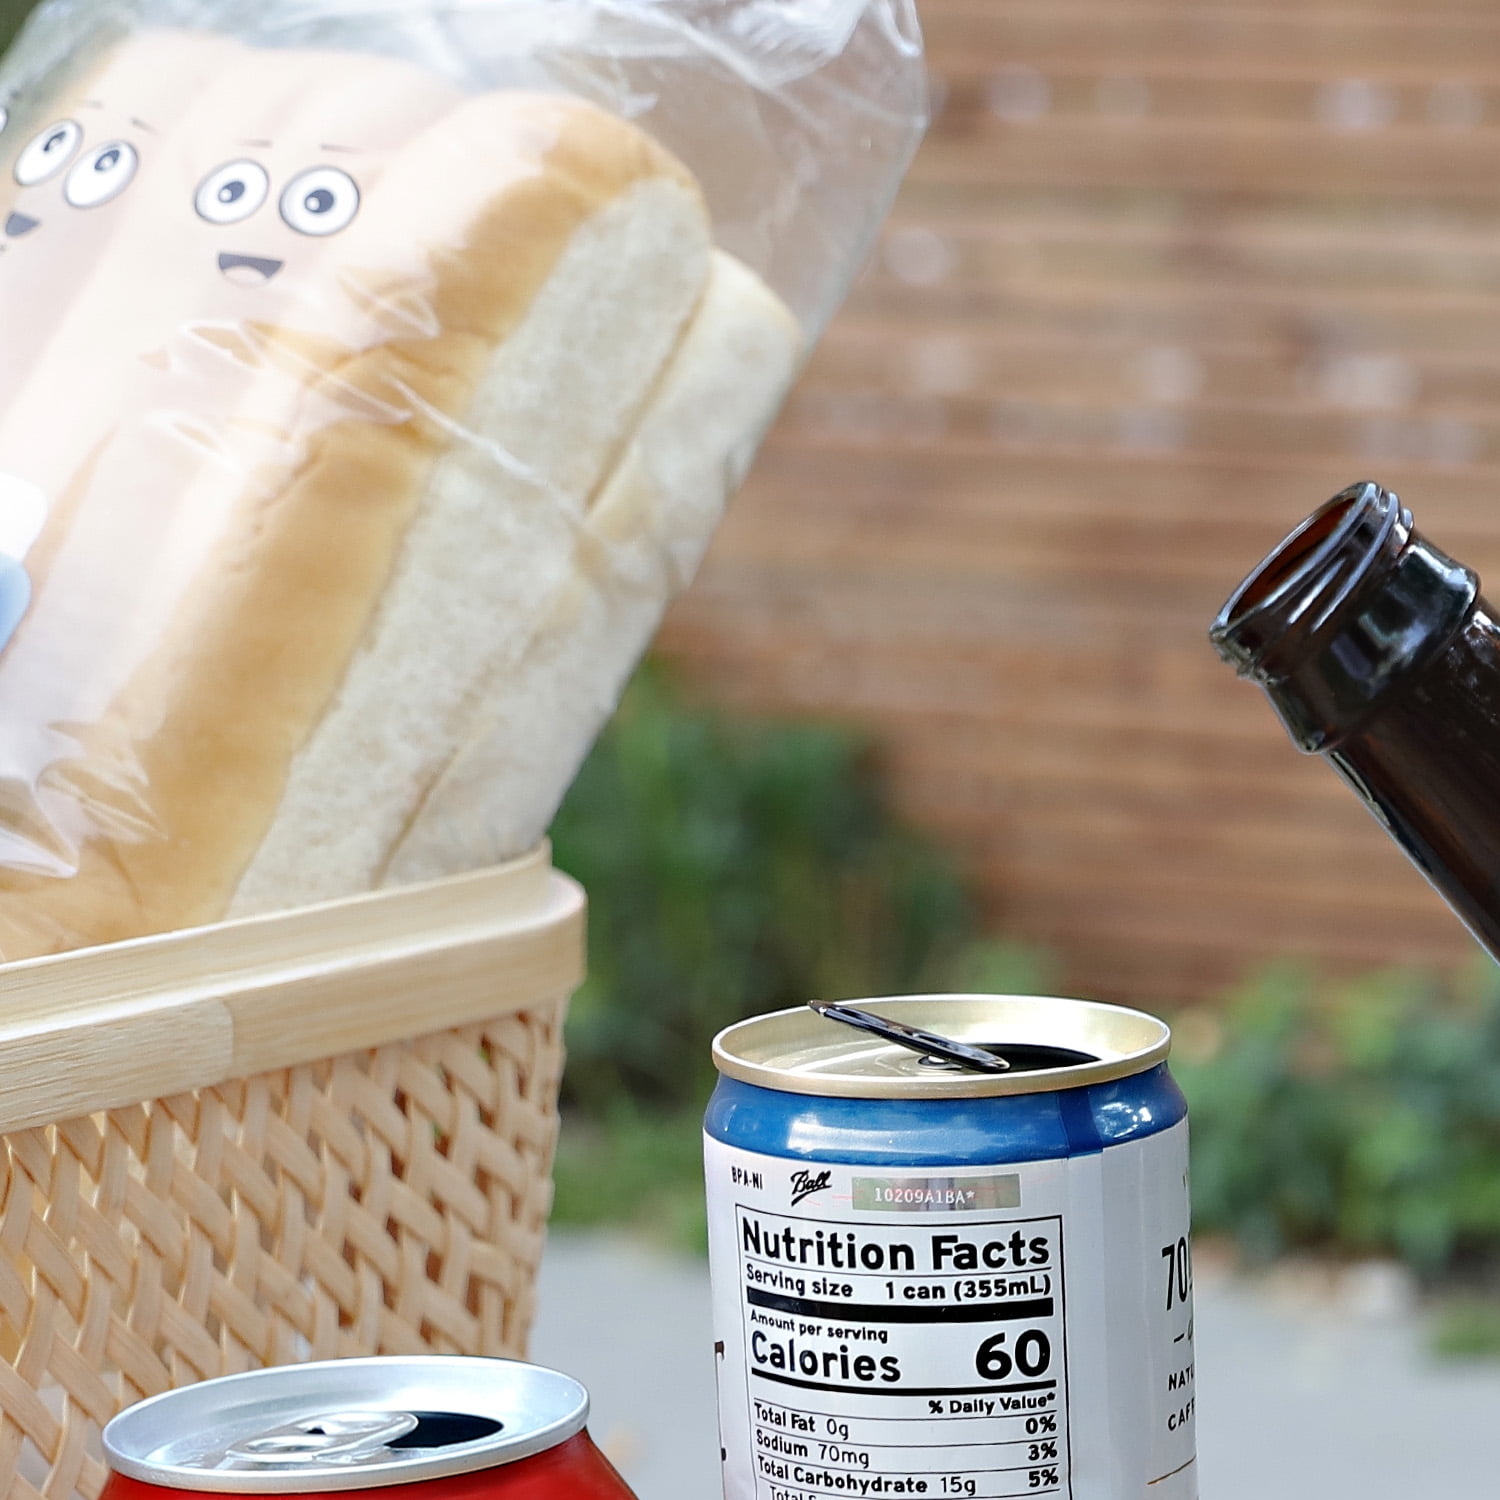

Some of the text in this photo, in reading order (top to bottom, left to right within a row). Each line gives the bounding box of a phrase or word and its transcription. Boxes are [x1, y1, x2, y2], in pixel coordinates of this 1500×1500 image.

[790, 1170, 832, 1206] Ball
[742, 1216, 1050, 1271] Nutrition Facts
[746, 1263, 1052, 1300] Serving size 1 can (355mL)
[1161, 1236, 1193, 1311] 70
[750, 1310, 888, 1344] Amount per serving
[751, 1330, 901, 1382] Calories
[976, 1329, 1051, 1379] 60
[754, 1403, 849, 1440] Total Fat 0g
[929, 1400, 943, 1414] %
[949, 1397, 994, 1415] Daily
[1025, 1415, 1056, 1434] 0%
[756, 1429, 870, 1468] Sodium 70mg
[1028, 1442, 1057, 1461] 3%
[758, 1456, 976, 1496] Total Carbohydrate 15g
[1028, 1468, 1058, 1487] 5%
